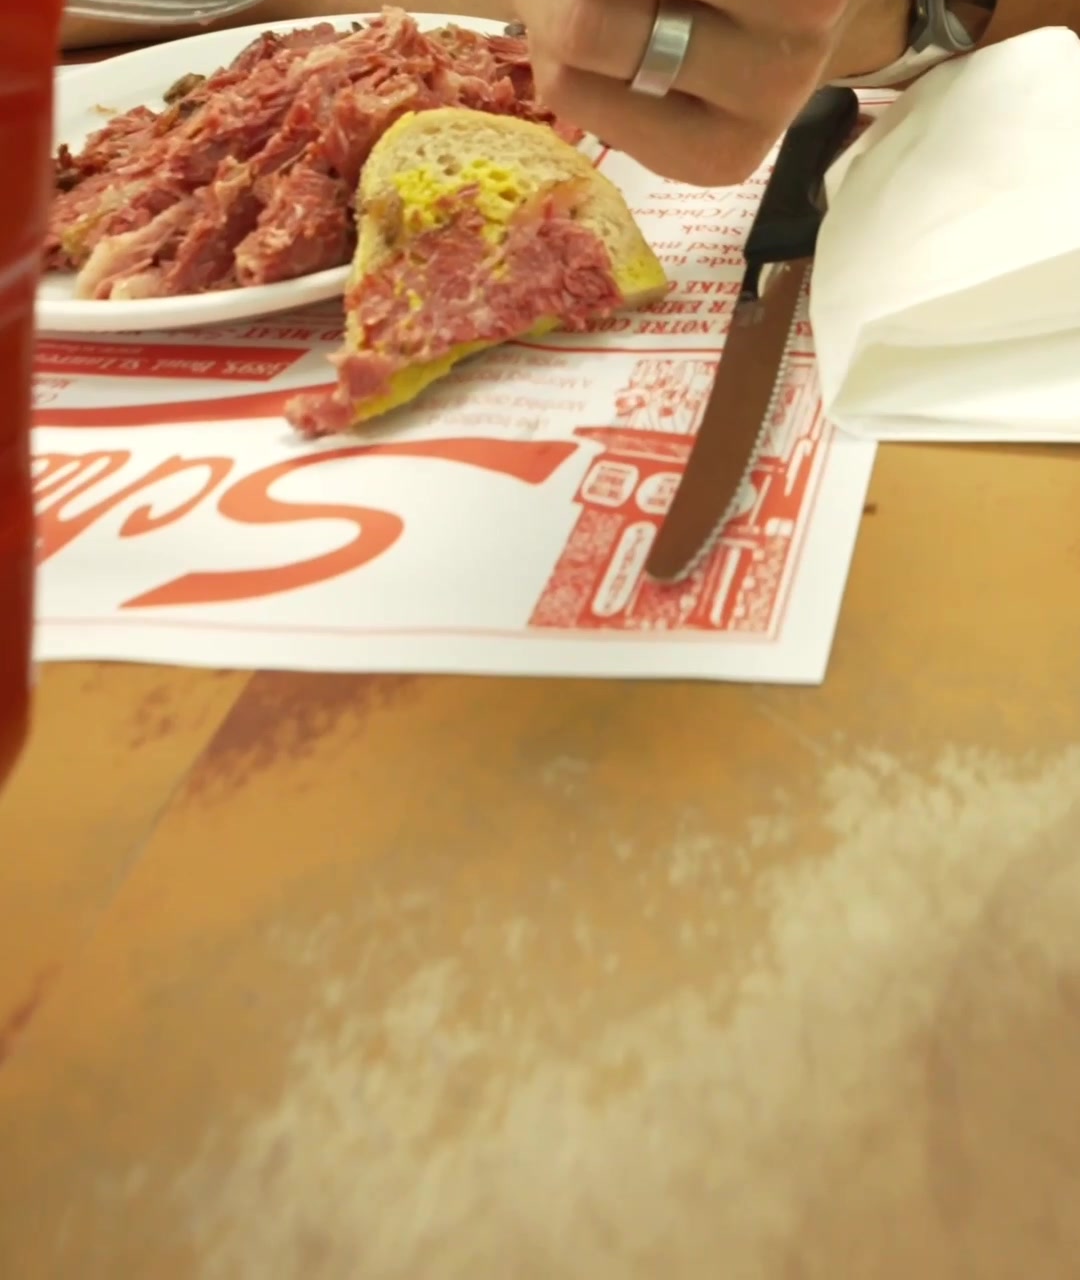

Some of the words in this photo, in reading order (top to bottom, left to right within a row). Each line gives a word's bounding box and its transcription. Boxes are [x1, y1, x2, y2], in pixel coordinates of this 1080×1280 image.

[681, 224, 744, 237] Steak
[680, 280, 742, 295] TAKE
[239, 324, 314, 341] MEAT
[632, 319, 716, 335] NOTRE
